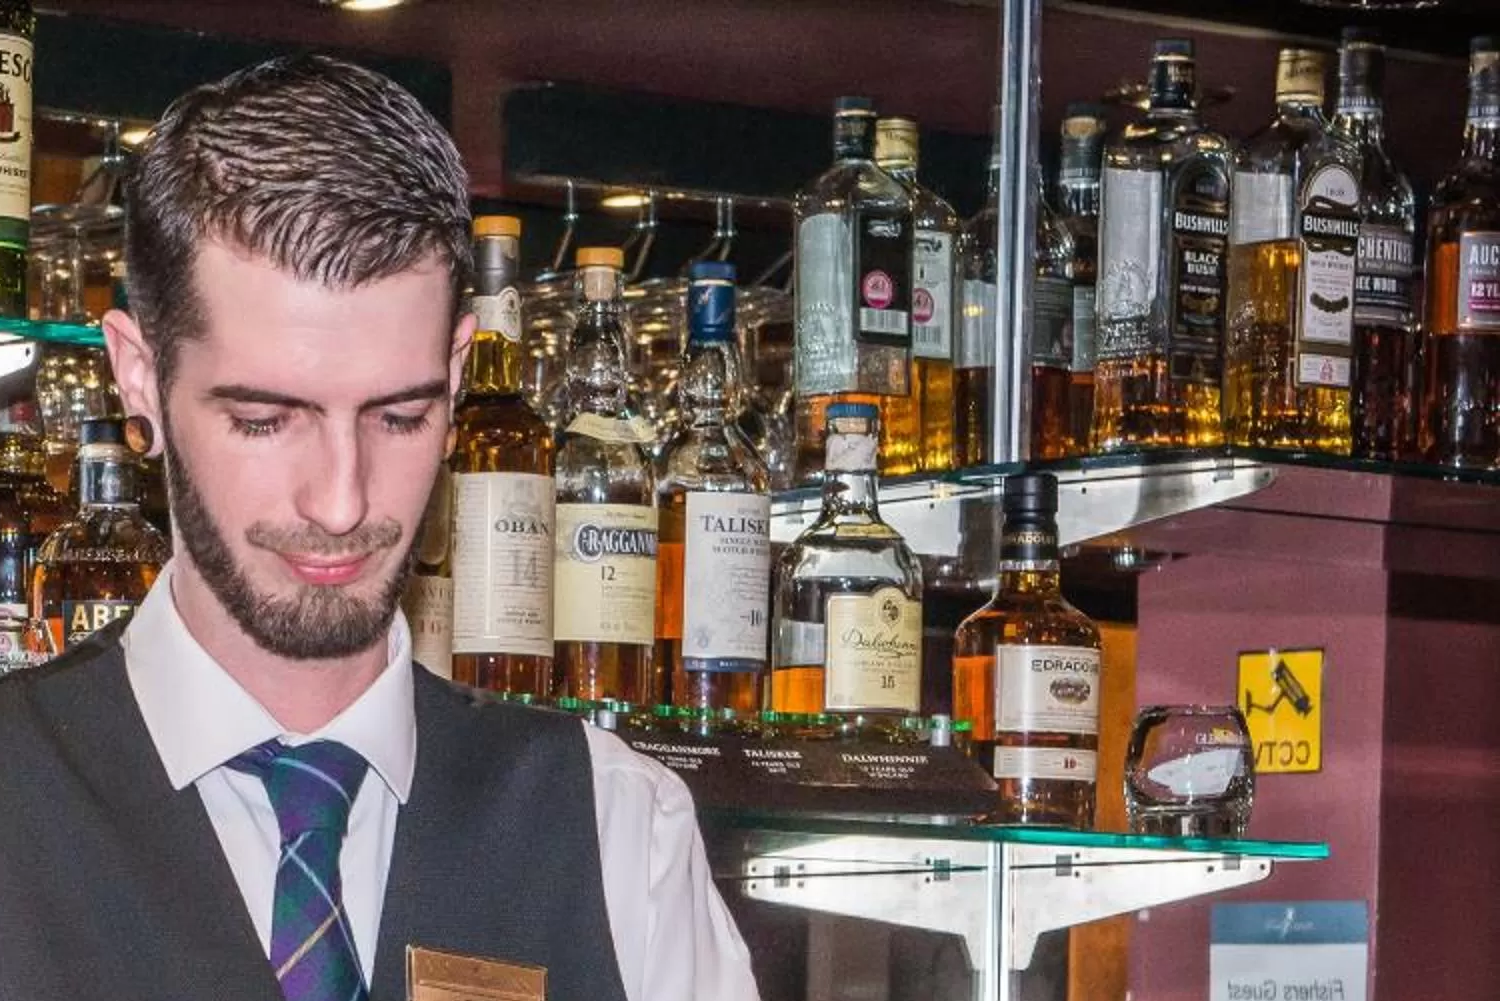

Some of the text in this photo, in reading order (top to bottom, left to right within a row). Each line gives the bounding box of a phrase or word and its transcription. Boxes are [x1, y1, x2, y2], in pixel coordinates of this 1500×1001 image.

[1303, 215, 1359, 238] BUSHMILLS
[1184, 250, 1220, 267] BLACK
[1186, 263, 1218, 277] BUSH
[494, 518, 550, 534] OBAN
[601, 565, 617, 582] 12
[841, 753, 929, 765] DALWHINNIE
